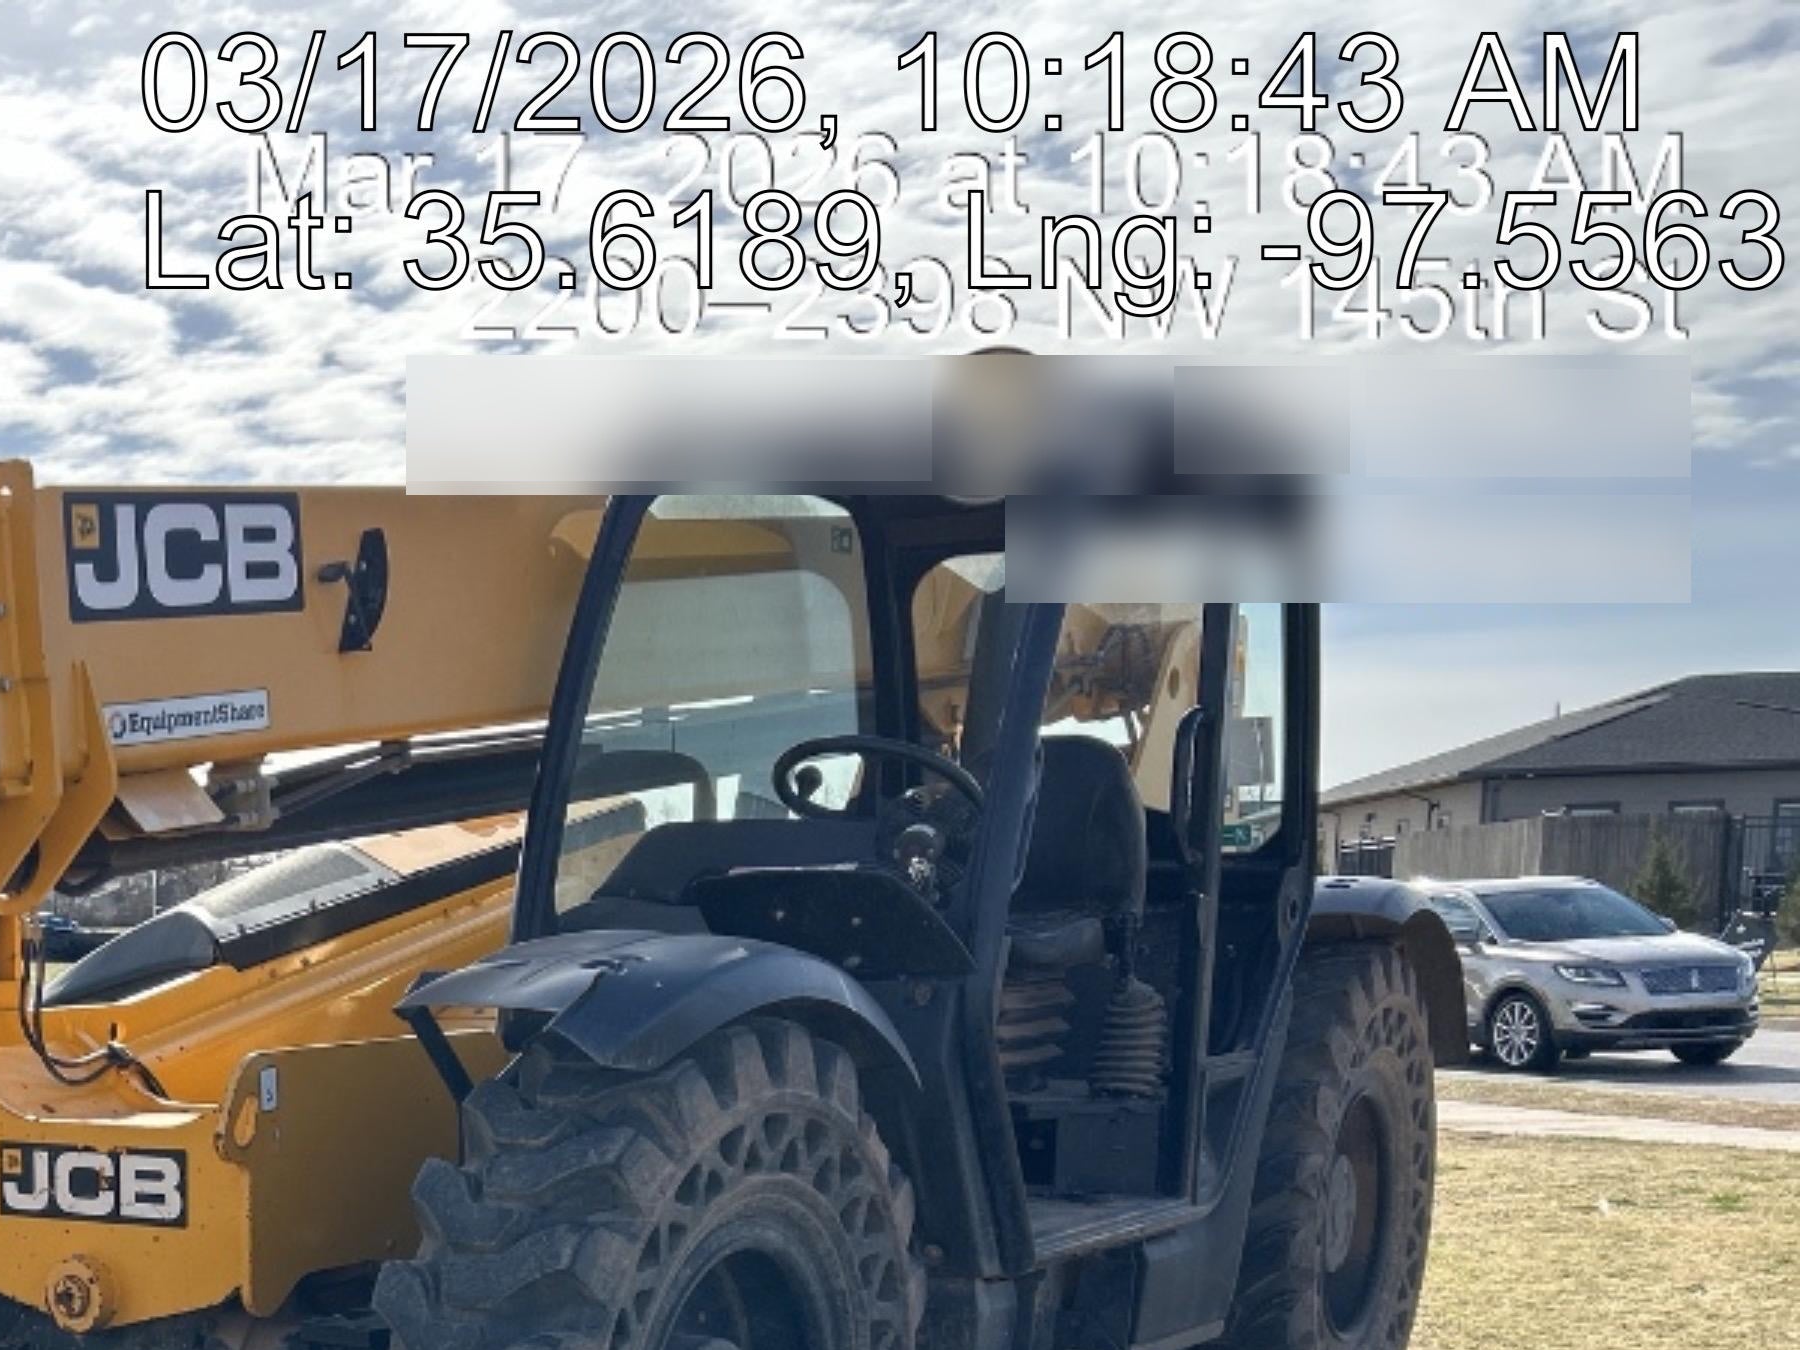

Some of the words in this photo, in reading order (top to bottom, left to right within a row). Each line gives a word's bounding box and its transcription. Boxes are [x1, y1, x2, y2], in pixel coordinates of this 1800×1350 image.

[73, 502, 299, 610] JCB
[128, 702, 266, 737] EquipmentShare
[2, 1150, 183, 1220] JCB
